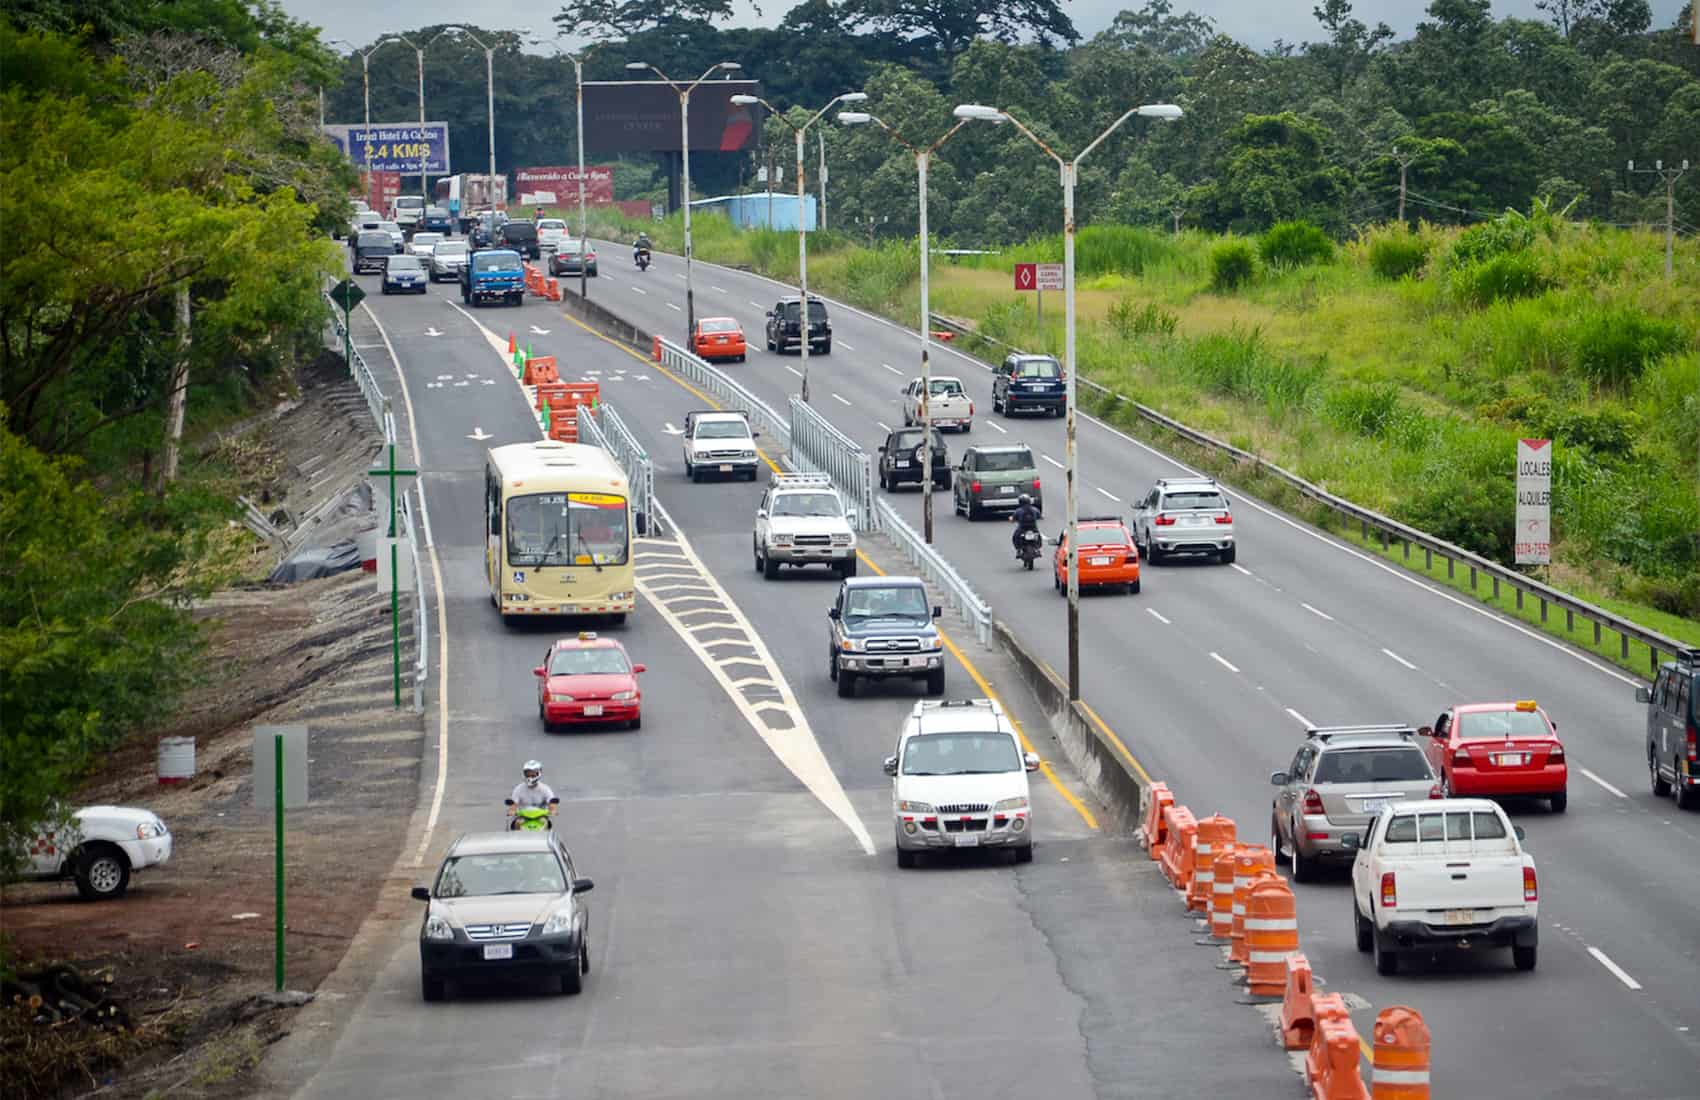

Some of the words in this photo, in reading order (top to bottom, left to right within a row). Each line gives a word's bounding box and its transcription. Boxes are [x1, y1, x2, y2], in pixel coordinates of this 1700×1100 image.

[379, 130, 400, 141] Hotel
[402, 130, 409, 140] &
[392, 143, 431, 158] KMS
[1520, 462, 1550, 476] LOCALES
